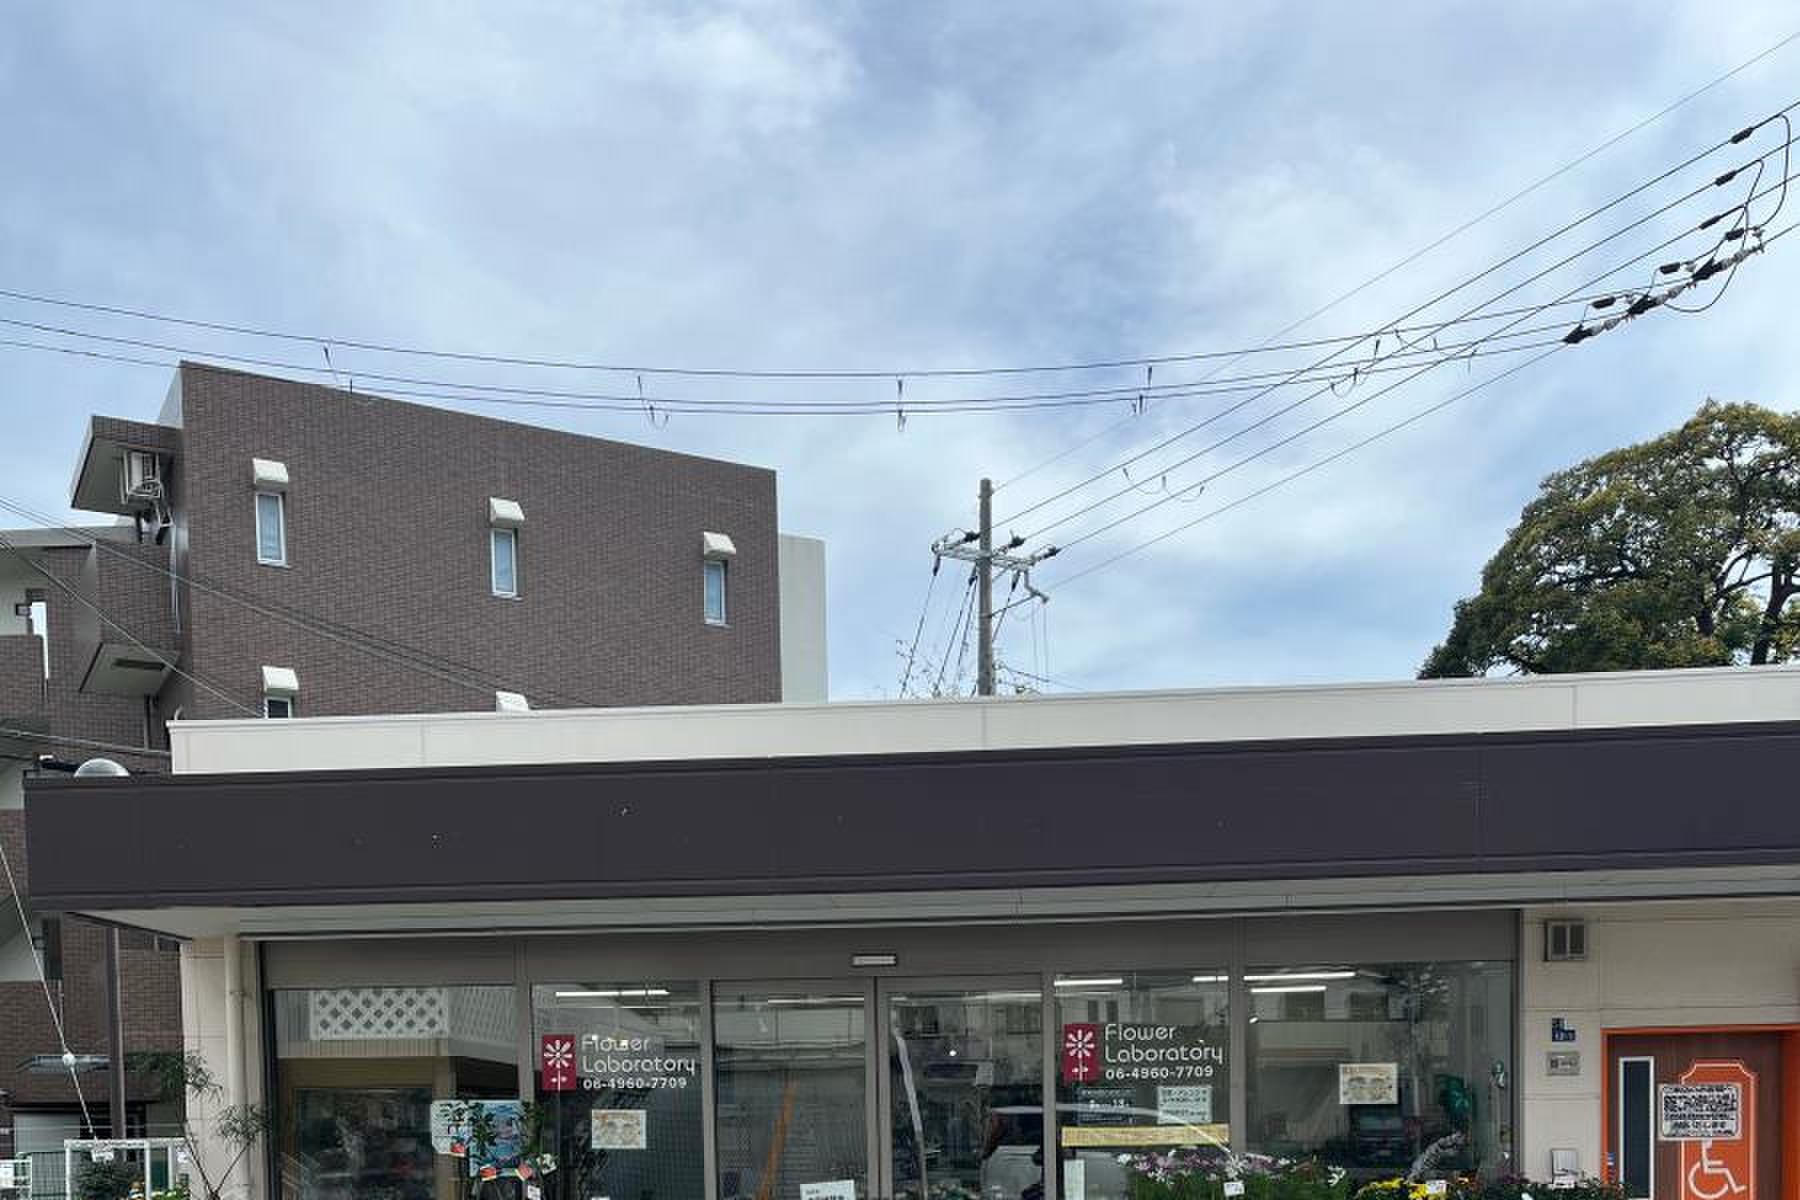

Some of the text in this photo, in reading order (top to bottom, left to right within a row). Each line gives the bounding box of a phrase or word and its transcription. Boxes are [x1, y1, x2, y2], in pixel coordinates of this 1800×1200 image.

[1105, 1024, 1176, 1040] Flower
[581, 1034, 649, 1051] Flower
[1105, 1045, 1223, 1064] Laboratory
[582, 1056, 695, 1075] Laboratory
[1105, 1065, 1214, 1079] 06-4960-7709
